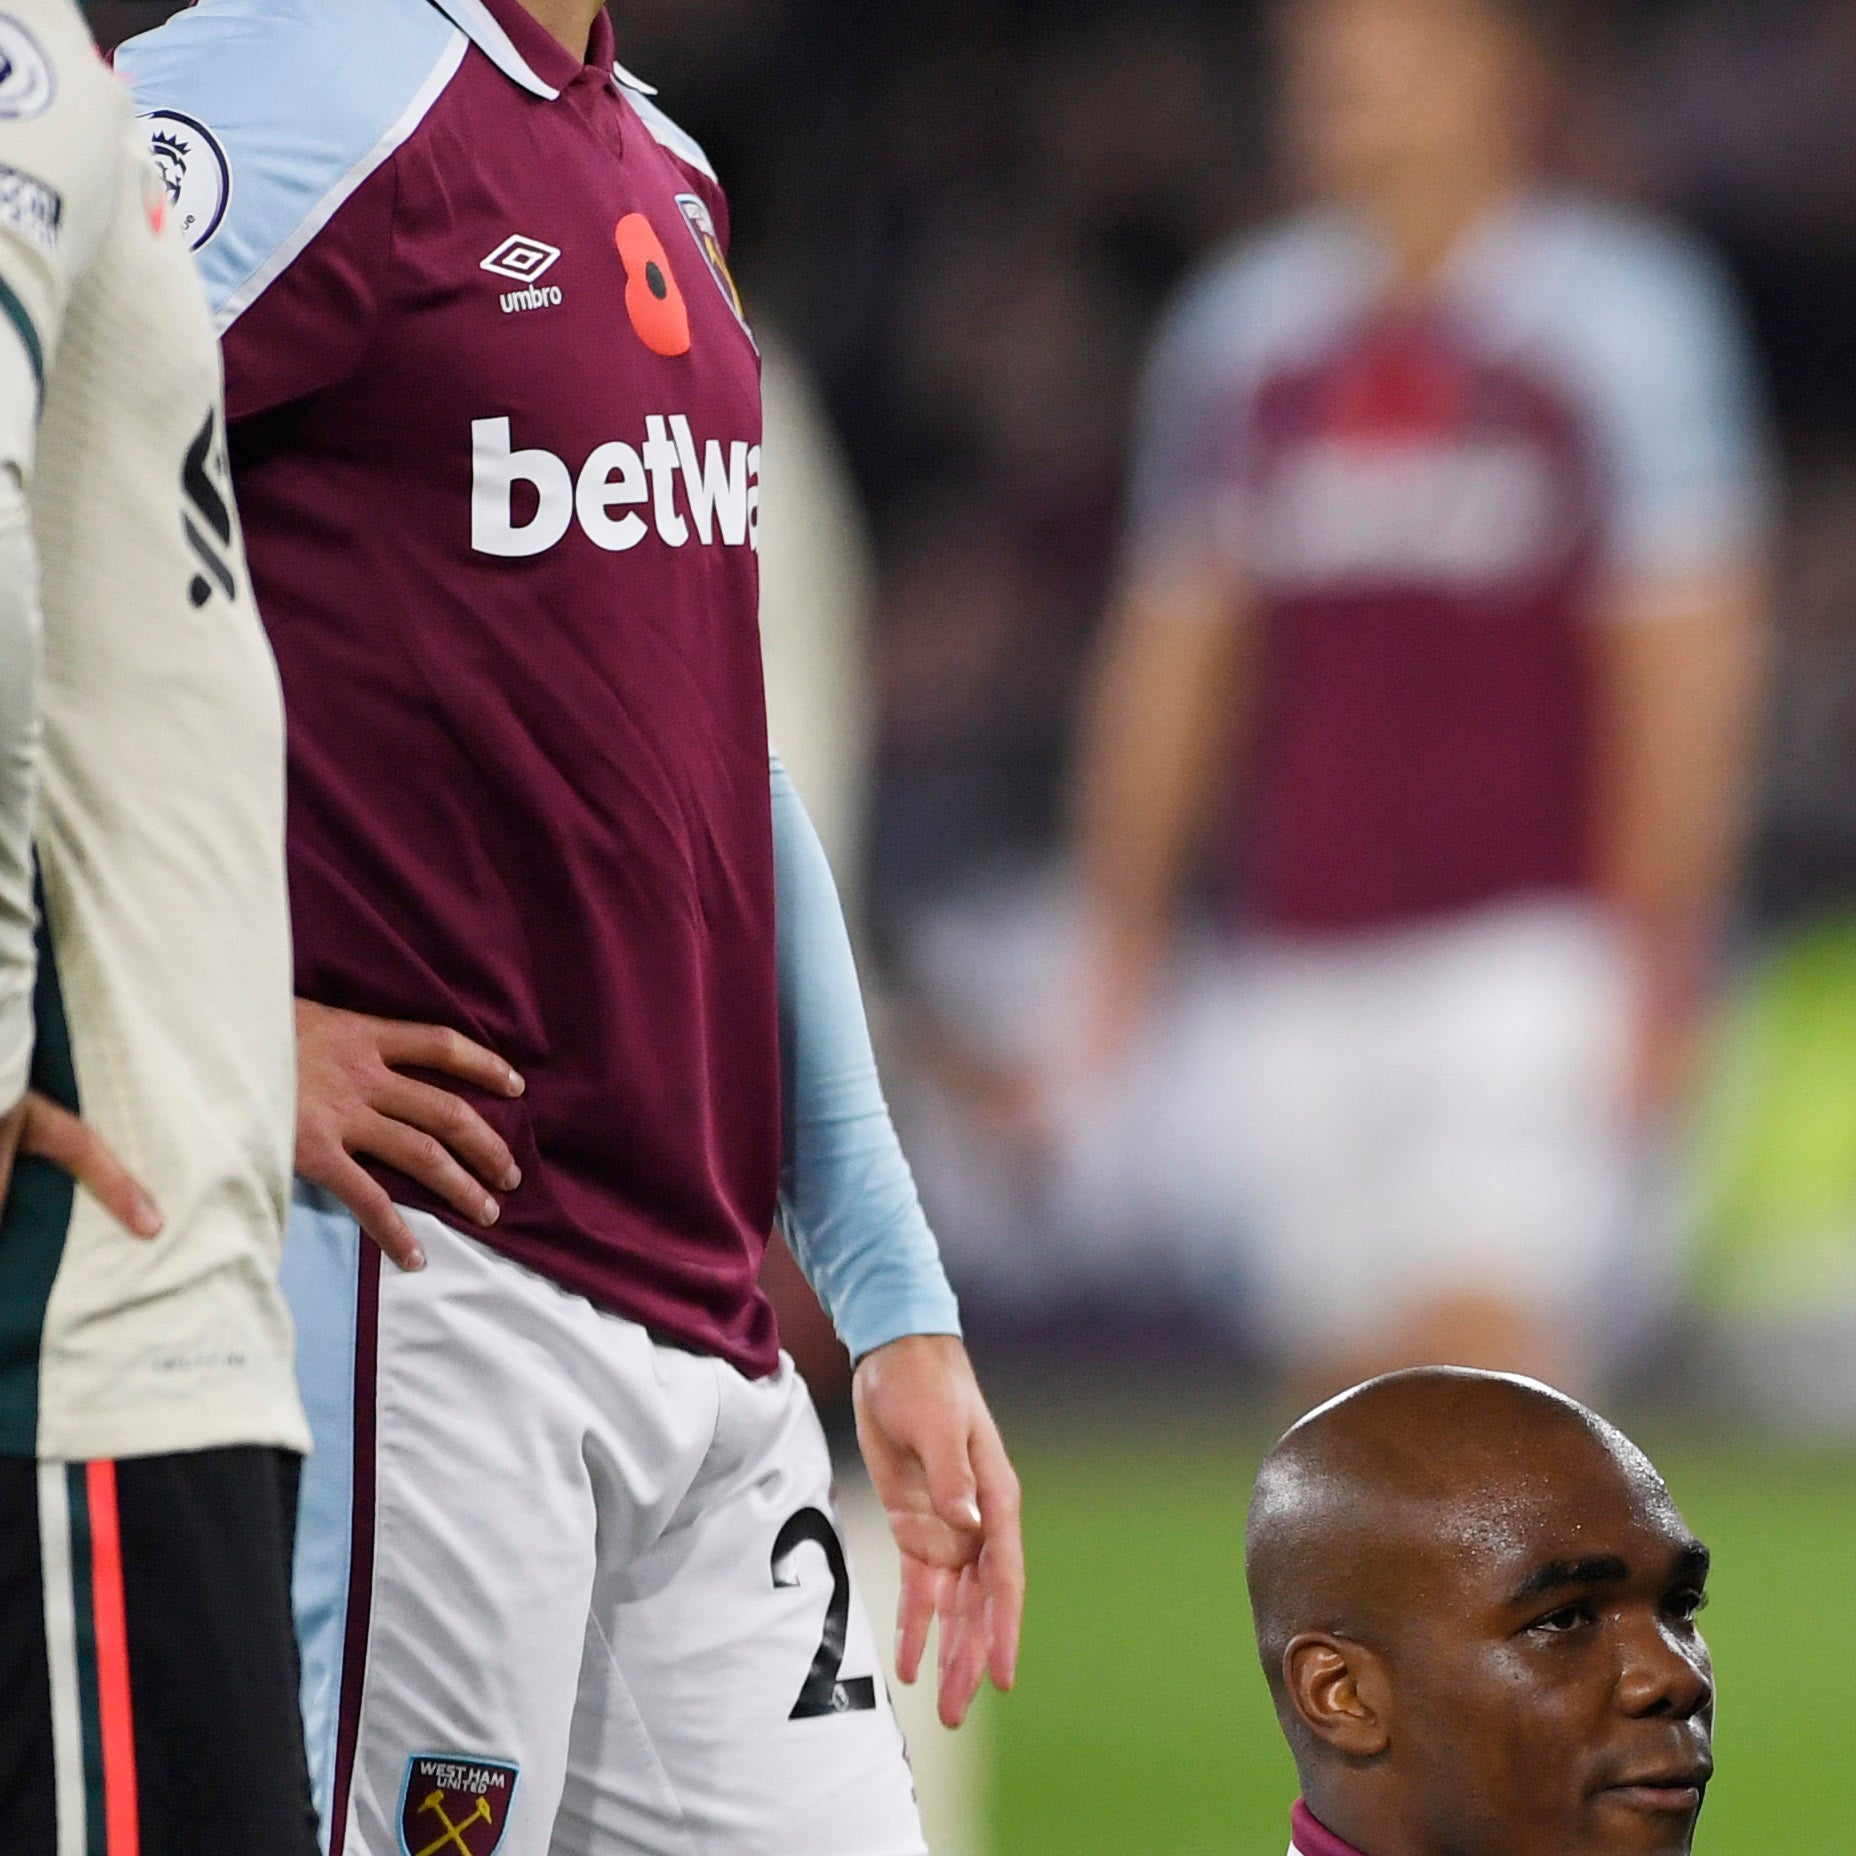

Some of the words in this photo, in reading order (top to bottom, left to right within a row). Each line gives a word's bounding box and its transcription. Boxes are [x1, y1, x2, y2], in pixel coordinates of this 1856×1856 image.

[499, 284, 562, 314] umbro
[771, 1506, 893, 1720] 2
[420, 1761, 467, 1781] WEST
[468, 1767, 505, 1789] HAM
[436, 1775, 488, 1794] UNITED
